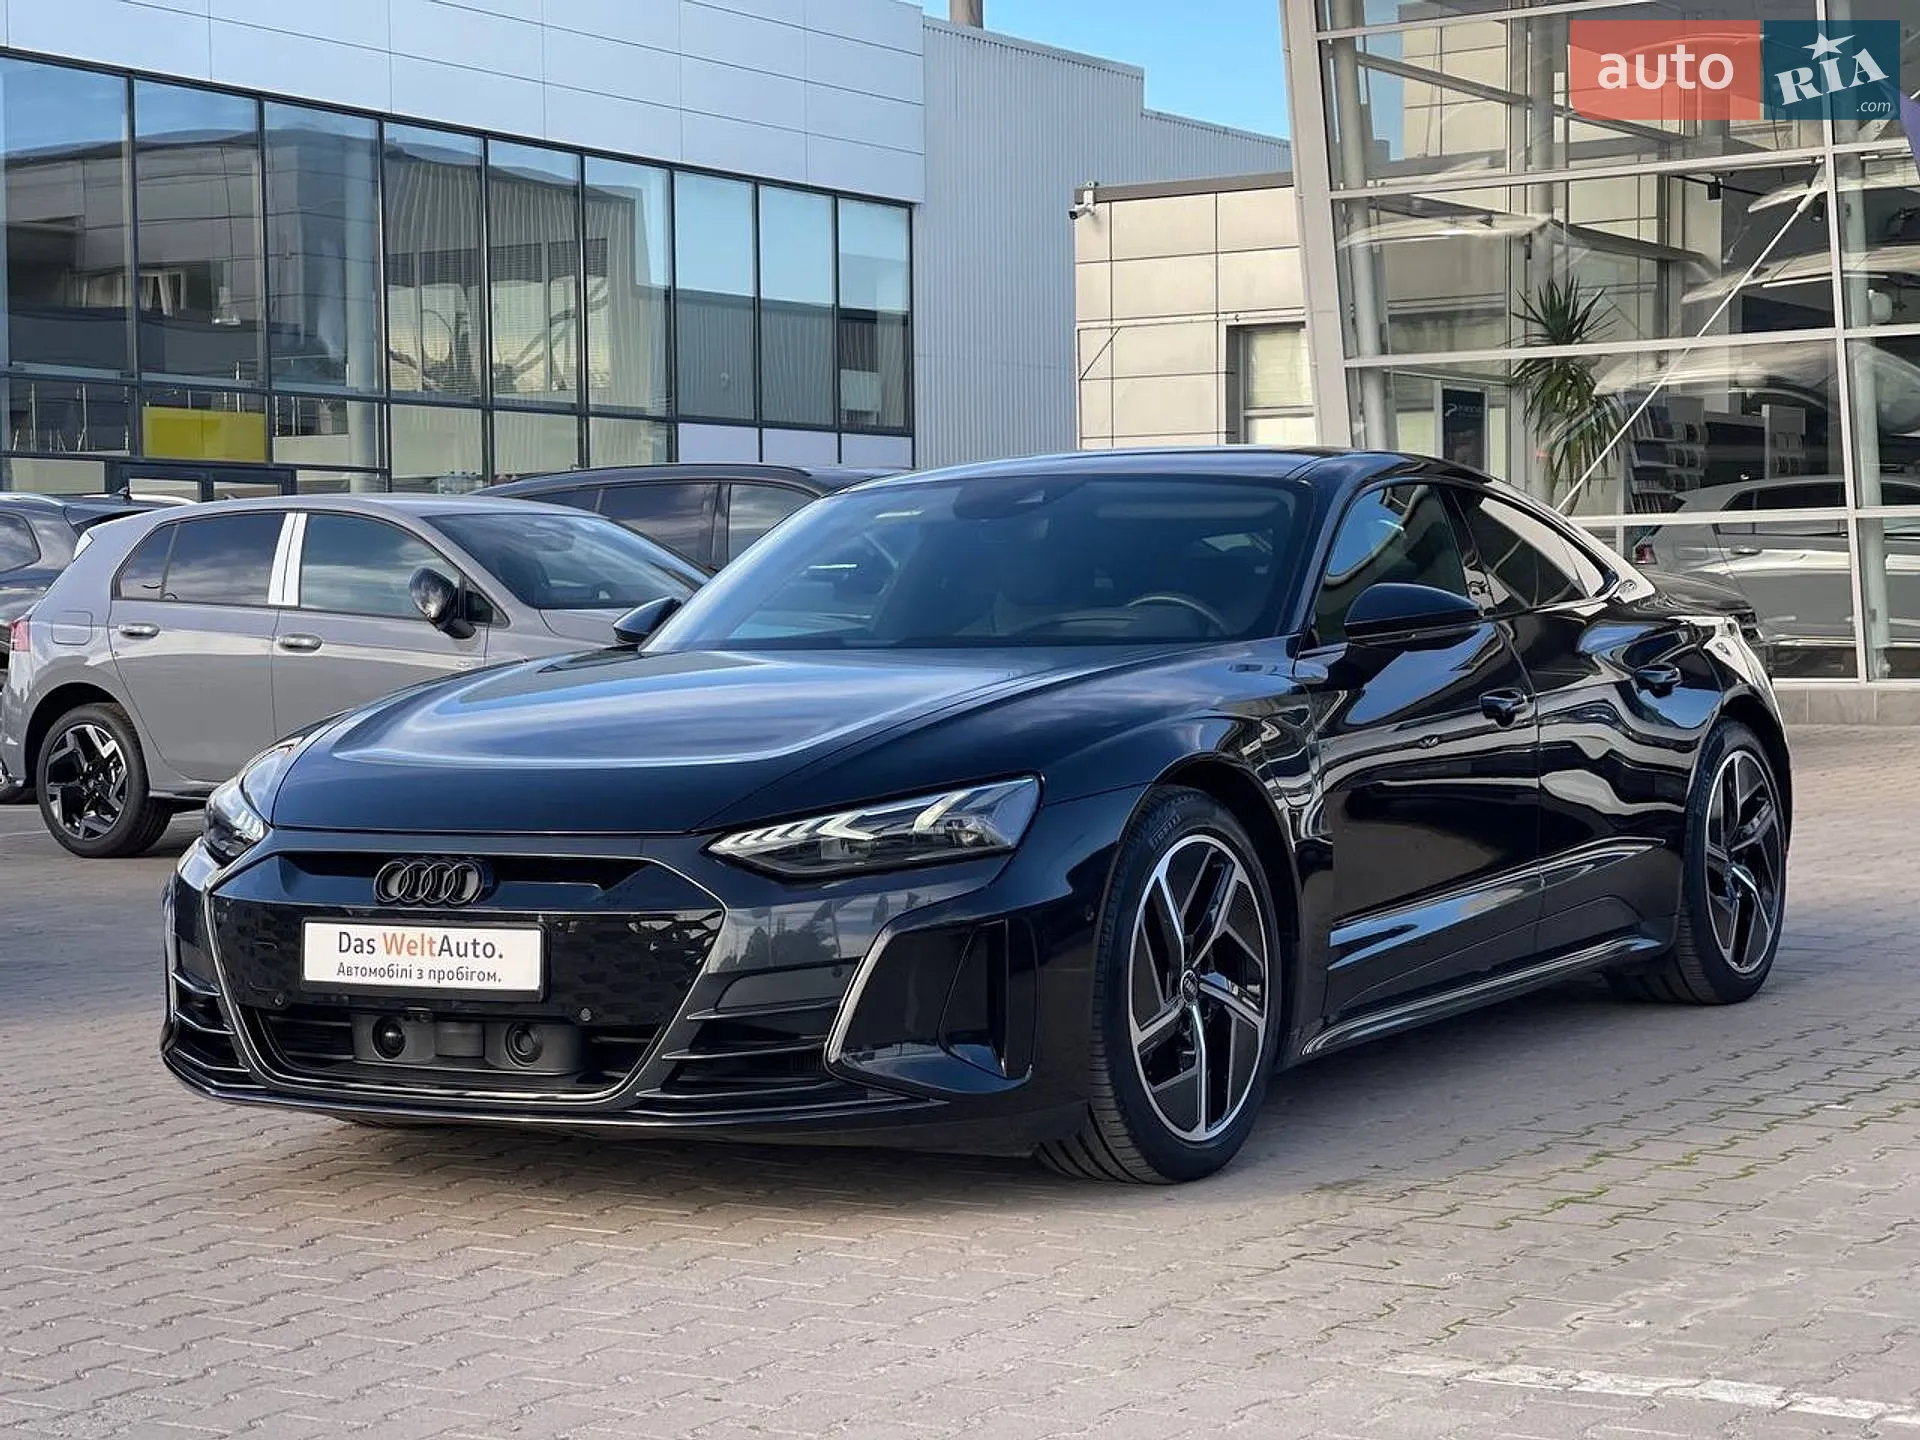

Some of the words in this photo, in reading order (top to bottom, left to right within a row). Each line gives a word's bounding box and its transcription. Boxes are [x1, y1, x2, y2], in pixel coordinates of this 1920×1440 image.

[338, 931, 376, 955] Das
[383, 932, 504, 959] WeltAuto.
[337, 962, 412, 979] Автомобілі
[417, 968, 424, 980] з
[428, 967, 502, 984] пробігом.
